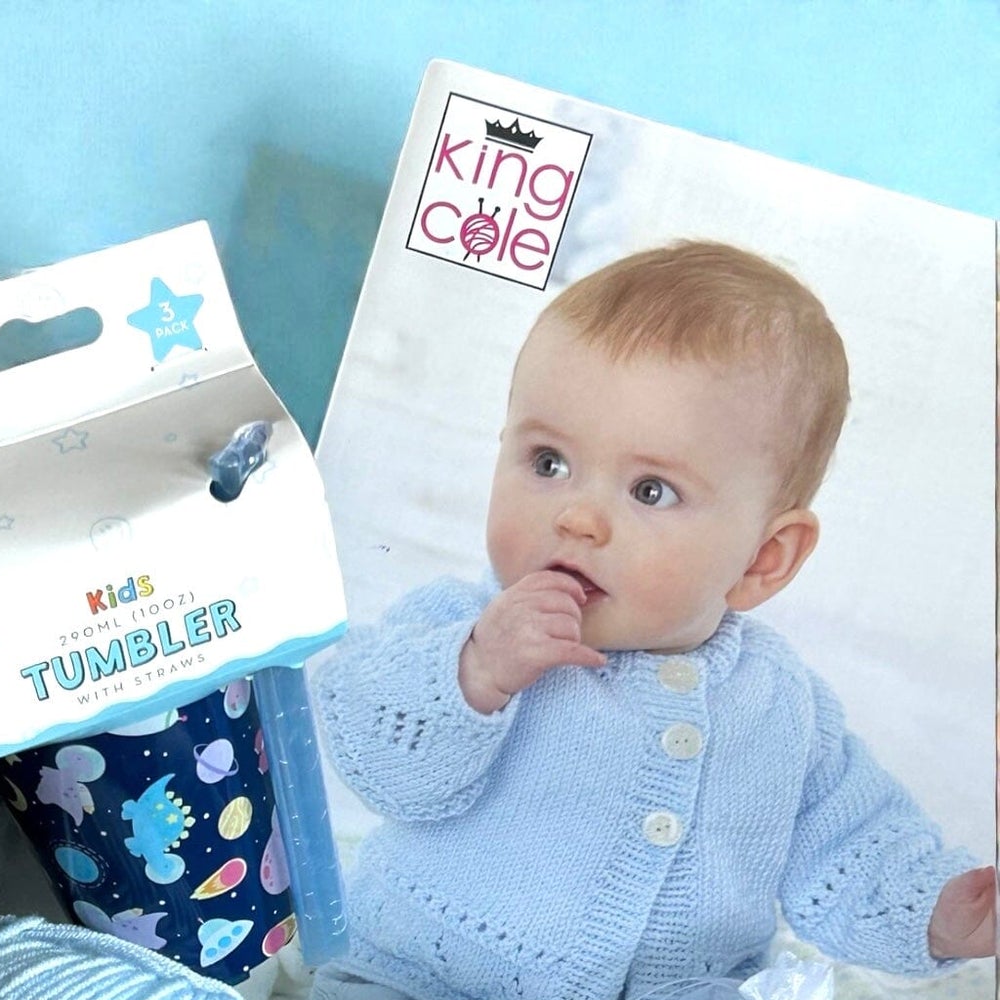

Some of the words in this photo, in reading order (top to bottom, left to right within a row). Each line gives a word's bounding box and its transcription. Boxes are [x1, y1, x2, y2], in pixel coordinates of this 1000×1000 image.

[434, 133, 575, 221] king
[420, 199, 550, 270] cole
[155, 320, 190, 339] PACK
[158, 301, 176, 322] 3
[86, 575, 155, 615] Kids
[20, 598, 242, 701] TUMBLER
[59, 617, 122, 647] 290ML
[76, 682, 125, 706] WITH
[134, 653, 206, 687] STRAWS
